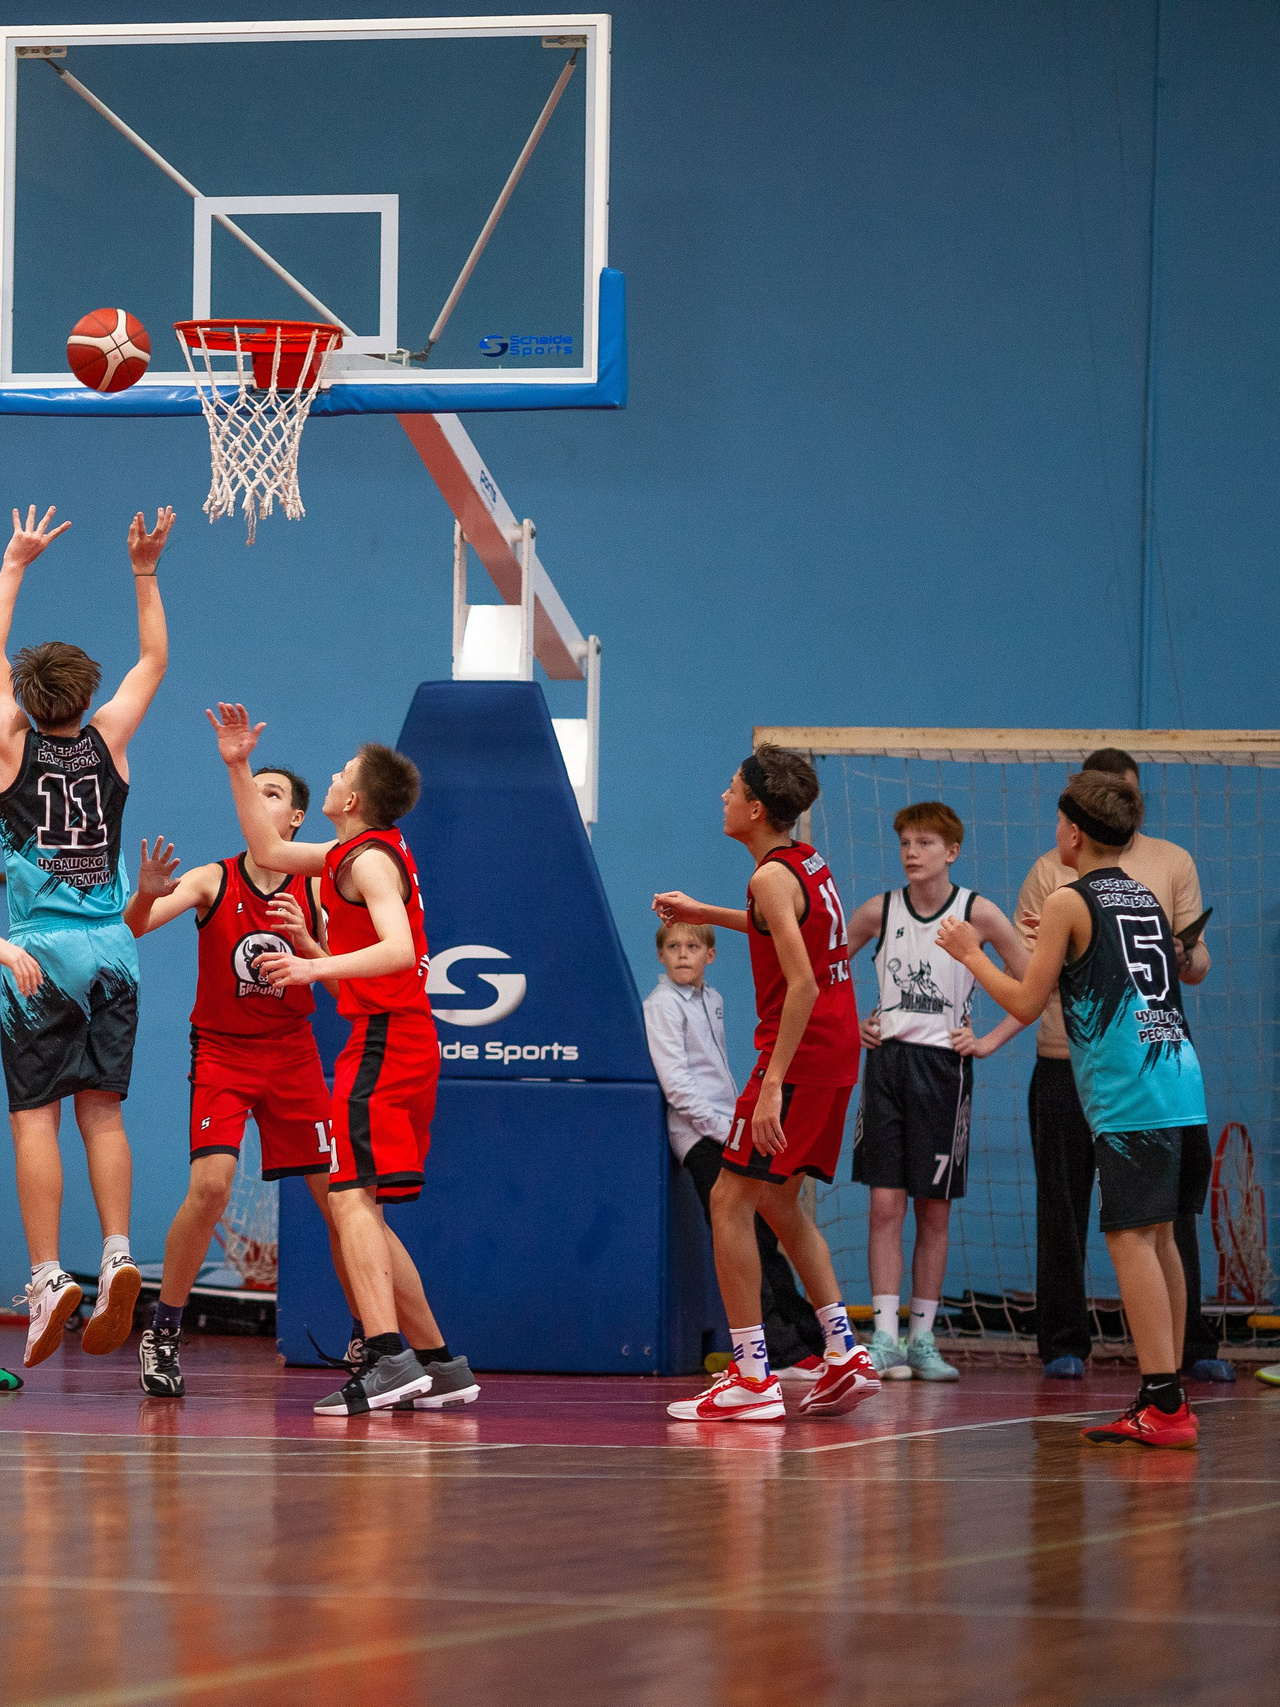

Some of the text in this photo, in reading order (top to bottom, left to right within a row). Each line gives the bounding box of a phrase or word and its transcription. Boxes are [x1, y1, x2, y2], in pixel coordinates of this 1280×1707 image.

[509, 345, 573, 358] Sports
[37, 772, 108, 850] 11
[818, 876, 849, 951] 11
[1115, 914, 1170, 1002] 5
[238, 981, 285, 998] БИЗОНЫ
[485, 1041, 579, 1065] Sports
[315, 1119, 333, 1153] 1
[931, 1154, 950, 1185] 7
